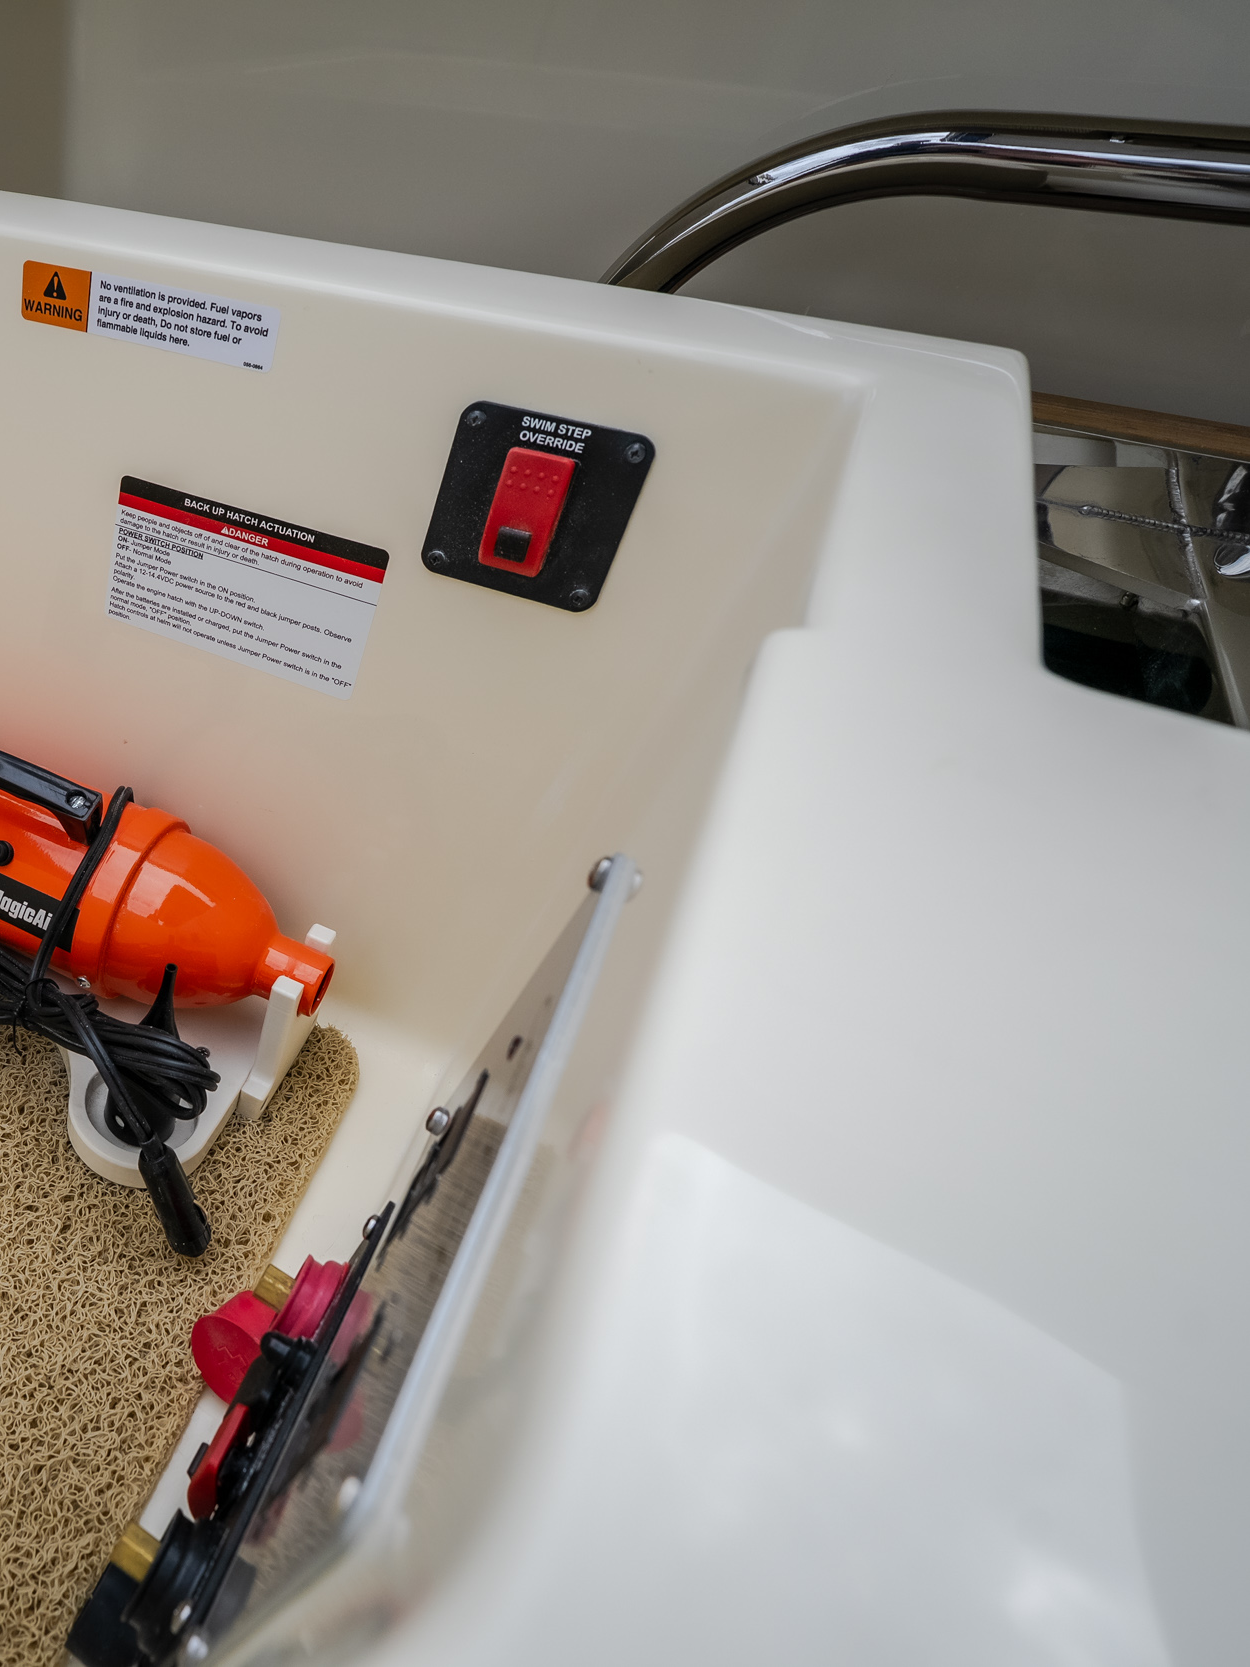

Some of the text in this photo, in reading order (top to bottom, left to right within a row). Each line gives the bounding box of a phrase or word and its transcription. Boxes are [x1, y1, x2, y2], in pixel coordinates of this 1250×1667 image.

[23, 298, 83, 322] WARNING
[98, 294, 269, 337] are a fire and explosion hazard. To avoid
[100, 279, 262, 322] No ventilation is provided. Fuel vapors
[96, 318, 190, 347] flammable liquids here.
[97, 305, 121, 320] injury
[122, 312, 131, 320] or
[160, 318, 172, 330] Do
[173, 323, 188, 333] not
[189, 326, 212, 338] store
[213, 330, 231, 342] fuel
[231, 336, 242, 345] or
[519, 430, 585, 454] OVERRIDE
[522, 416, 592, 440] SWIM STEP
[184, 498, 315, 543] BACK UP HATCH ACTUATION
[229, 528, 269, 547] DANGER
[118, 527, 204, 560] POWER SWITCH POSITION
[119, 517, 144, 530] damage
[151, 527, 161, 535] the
[161, 530, 179, 541] hatch
[187, 539, 205, 549] result
[205, 543, 212, 551] in
[213, 546, 231, 558] injury
[239, 554, 259, 566] death.
[120, 508, 137, 519] Keep
[137, 515, 157, 526] people
[158, 521, 170, 530] and
[170, 525, 193, 537] objects
[210, 538, 224, 546] and
[224, 541, 240, 551] clear
[249, 548, 260, 557] the
[260, 552, 279, 563] hatch
[280, 558, 302, 571] during
[302, 566, 334, 580] operation
[335, 575, 343, 583] to
[343, 578, 363, 589] avoid
[130, 539, 153, 551] Jumper
[153, 546, 170, 557] Mode
[132, 547, 153, 559] Normal
[154, 554, 172, 565] Mode
[113, 568, 135, 580] polarity.
[115, 552, 126, 561] Put
[126, 556, 136, 564] the
[136, 559, 159, 571] Jumper
[159, 566, 179, 577] Power
[179, 574, 198, 584] switch
[206, 582, 217, 590] the
[217, 585, 229, 594] ON
[229, 590, 255, 603] position.
[108, 608, 131, 620] position.
[109, 594, 130, 605] normal
[129, 601, 148, 612] mode,
[167, 613, 191, 626] position.
[112, 575, 264, 631] Operate the engine hatch with the UP-DOWN switch.
[114, 560, 133, 571] Attach
[139, 568, 174, 584] 12-14.4VDC
[174, 580, 194, 591] power
[194, 587, 215, 598] source
[216, 593, 223, 601] to
[223, 596, 234, 604] the
[235, 600, 246, 608] red
[246, 604, 260, 613] and
[260, 607, 277, 619] black
[277, 613, 301, 626] jumper
[301, 622, 322, 634] posts.
[323, 628, 352, 643] Observe
[109, 600, 126, 611] Hatch
[126, 607, 149, 619] controls
[156, 616, 171, 626] helm
[182, 626, 192, 634] not
[192, 630, 216, 642] operate
[216, 638, 236, 649] unless
[237, 645, 261, 657] Jumper
[261, 653, 282, 665] Power
[283, 661, 303, 672] switch
[304, 667, 310, 675] is
[311, 670, 318, 678] in
[318, 673, 330, 682] the
[110, 586, 125, 596] After
[125, 591, 135, 599] the
[135, 594, 160, 608] batteries
[171, 606, 197, 620] installed
[204, 618, 231, 632] charged,
[232, 628, 243, 636] put
[243, 631, 254, 639] the
[254, 635, 279, 648] Jumper
[279, 643, 301, 655] Power
[301, 651, 322, 663] switch
[323, 658, 330, 666] in
[330, 661, 342, 669] the
